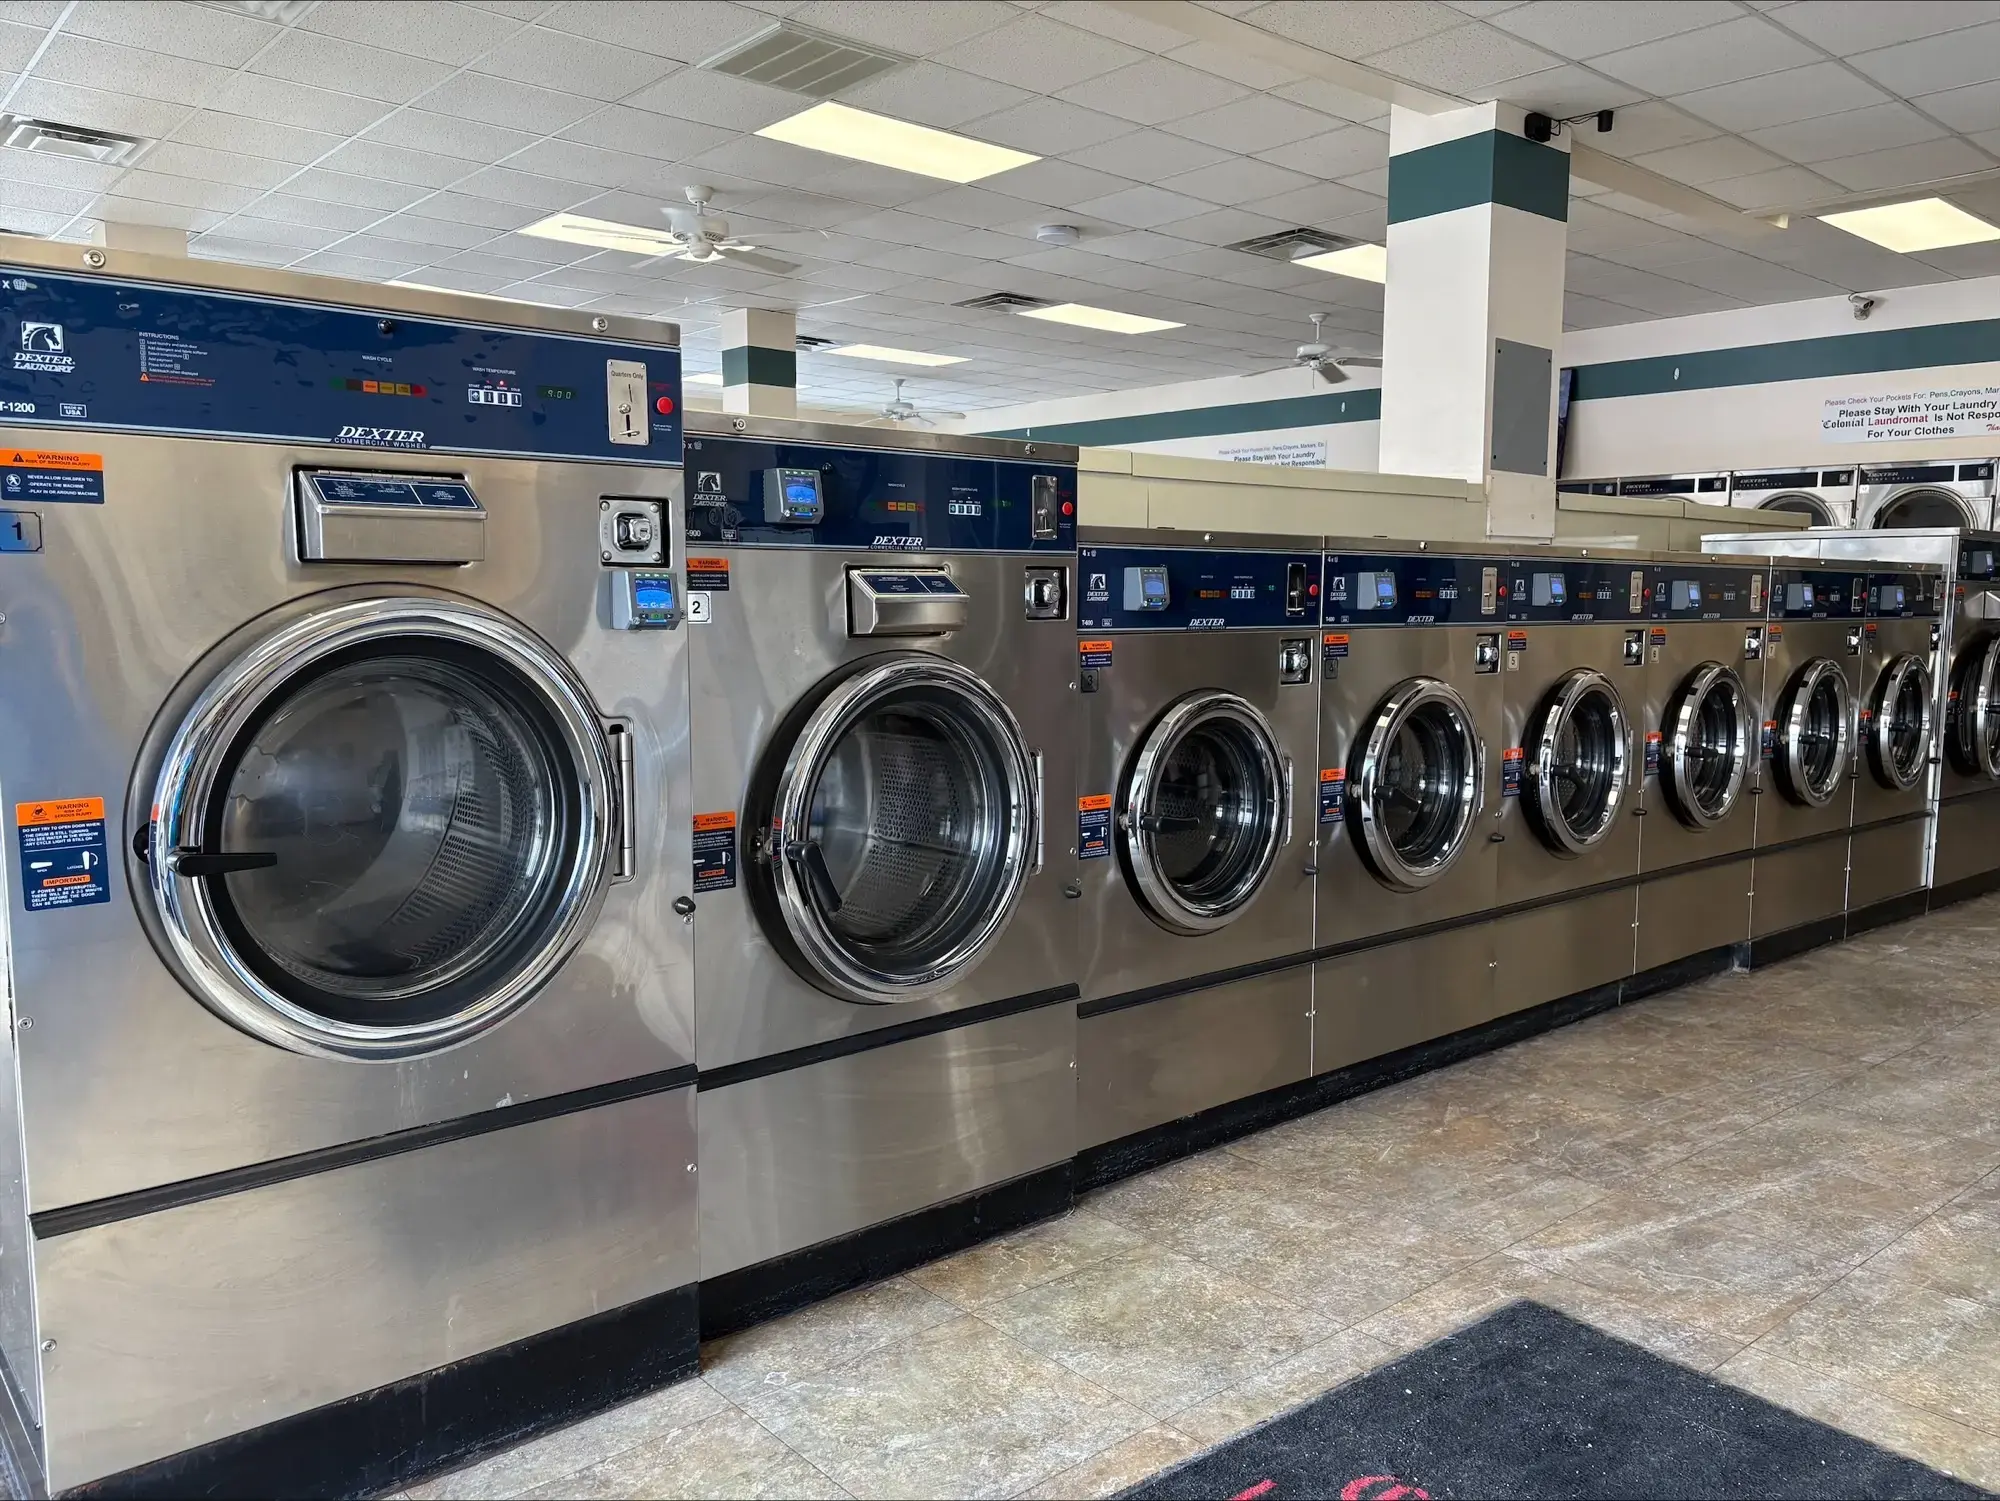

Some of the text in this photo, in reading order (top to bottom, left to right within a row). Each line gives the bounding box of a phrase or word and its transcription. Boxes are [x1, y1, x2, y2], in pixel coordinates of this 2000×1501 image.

[139, 332, 179, 340] INSTRUCTIONS
[13, 362, 75, 373] LAUNDRY
[611, 370, 631, 378] Quarters
[1874, 407, 1895, 416] Stay
[1898, 405, 1920, 413] With
[1924, 403, 1950, 411] Your
[1953, 400, 1997, 409] Laundry
[1868, 414, 1928, 426] Laundromat
[1947, 412, 1964, 420] Not
[337, 426, 424, 442] DEXTER
[1868, 430, 1884, 438] For
[1887, 429, 1911, 437] Your
[1915, 426, 1954, 435] Clothes
[335, 437, 389, 446] COMMERCIAL
[1292, 451, 1315, 459] Laundry
[12, 522, 21, 540] 1
[872, 536, 923, 546] DEXTER
[692, 601, 700, 614] 2
[1088, 675, 1093, 685] 3
[46, 876, 86, 885] IMPORTANT
